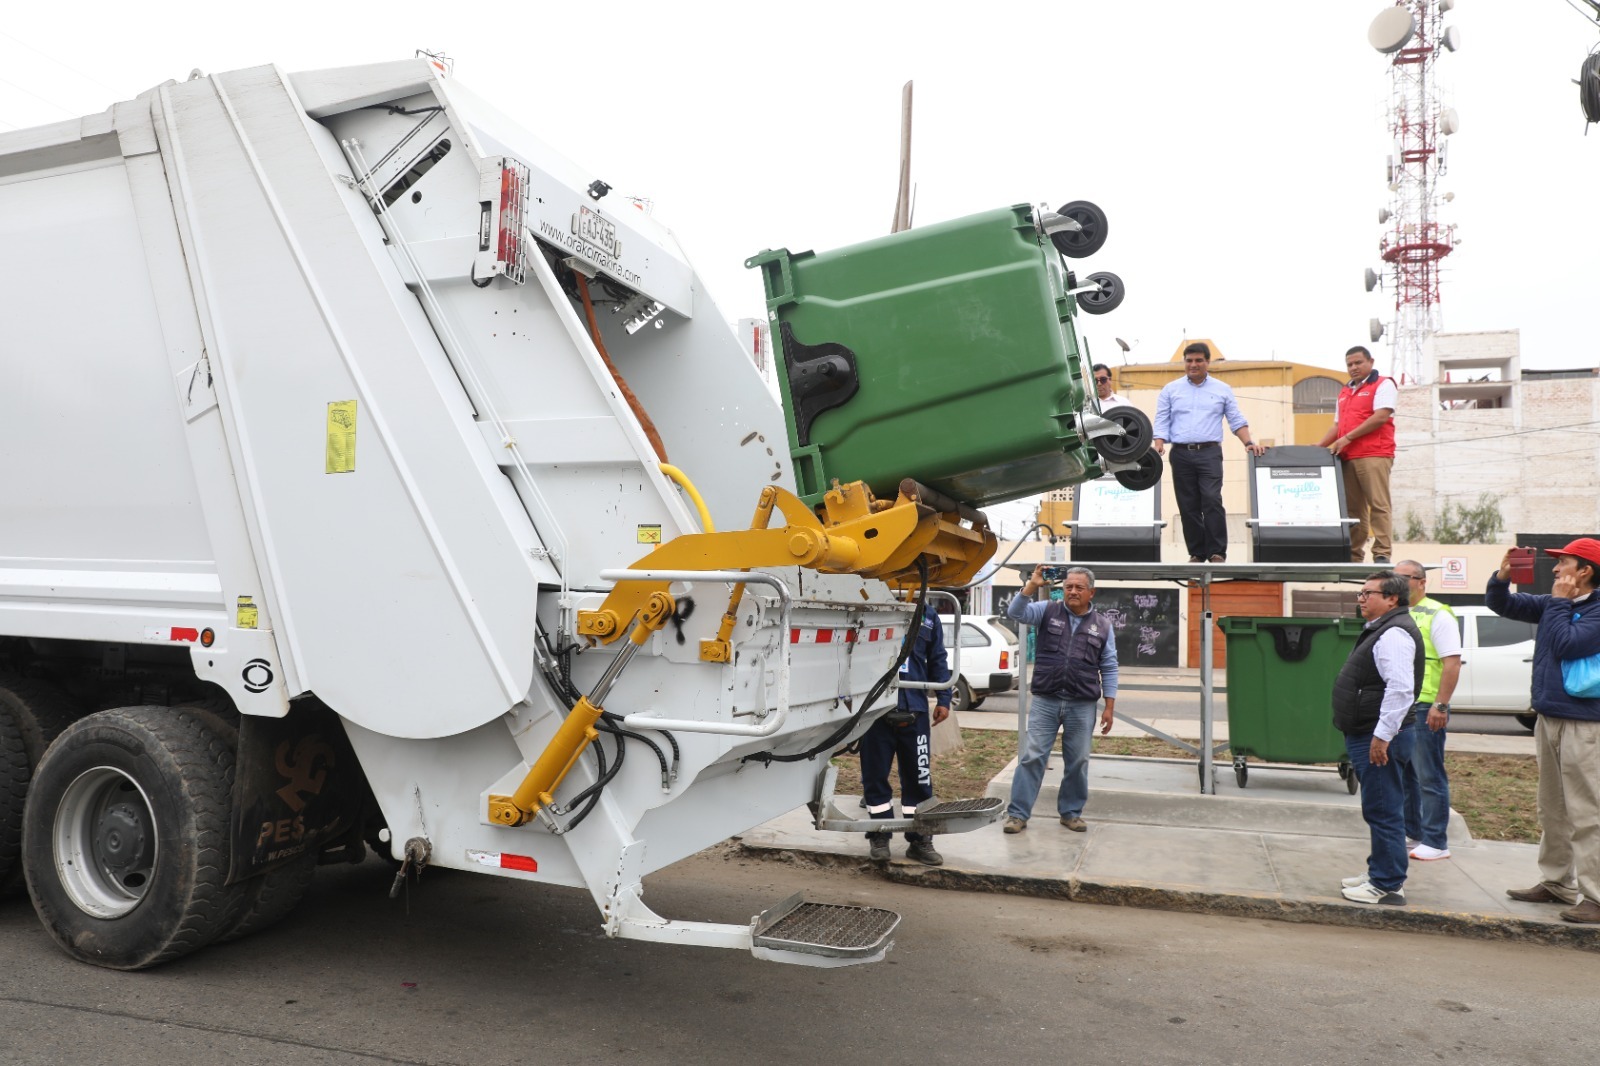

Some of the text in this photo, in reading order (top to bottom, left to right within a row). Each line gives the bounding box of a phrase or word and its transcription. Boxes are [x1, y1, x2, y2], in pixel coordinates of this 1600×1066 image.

[582, 218, 614, 250] EAJ-435
[1272, 481, 1320, 498] Trujillo
[917, 734, 931, 787] SEGAT
